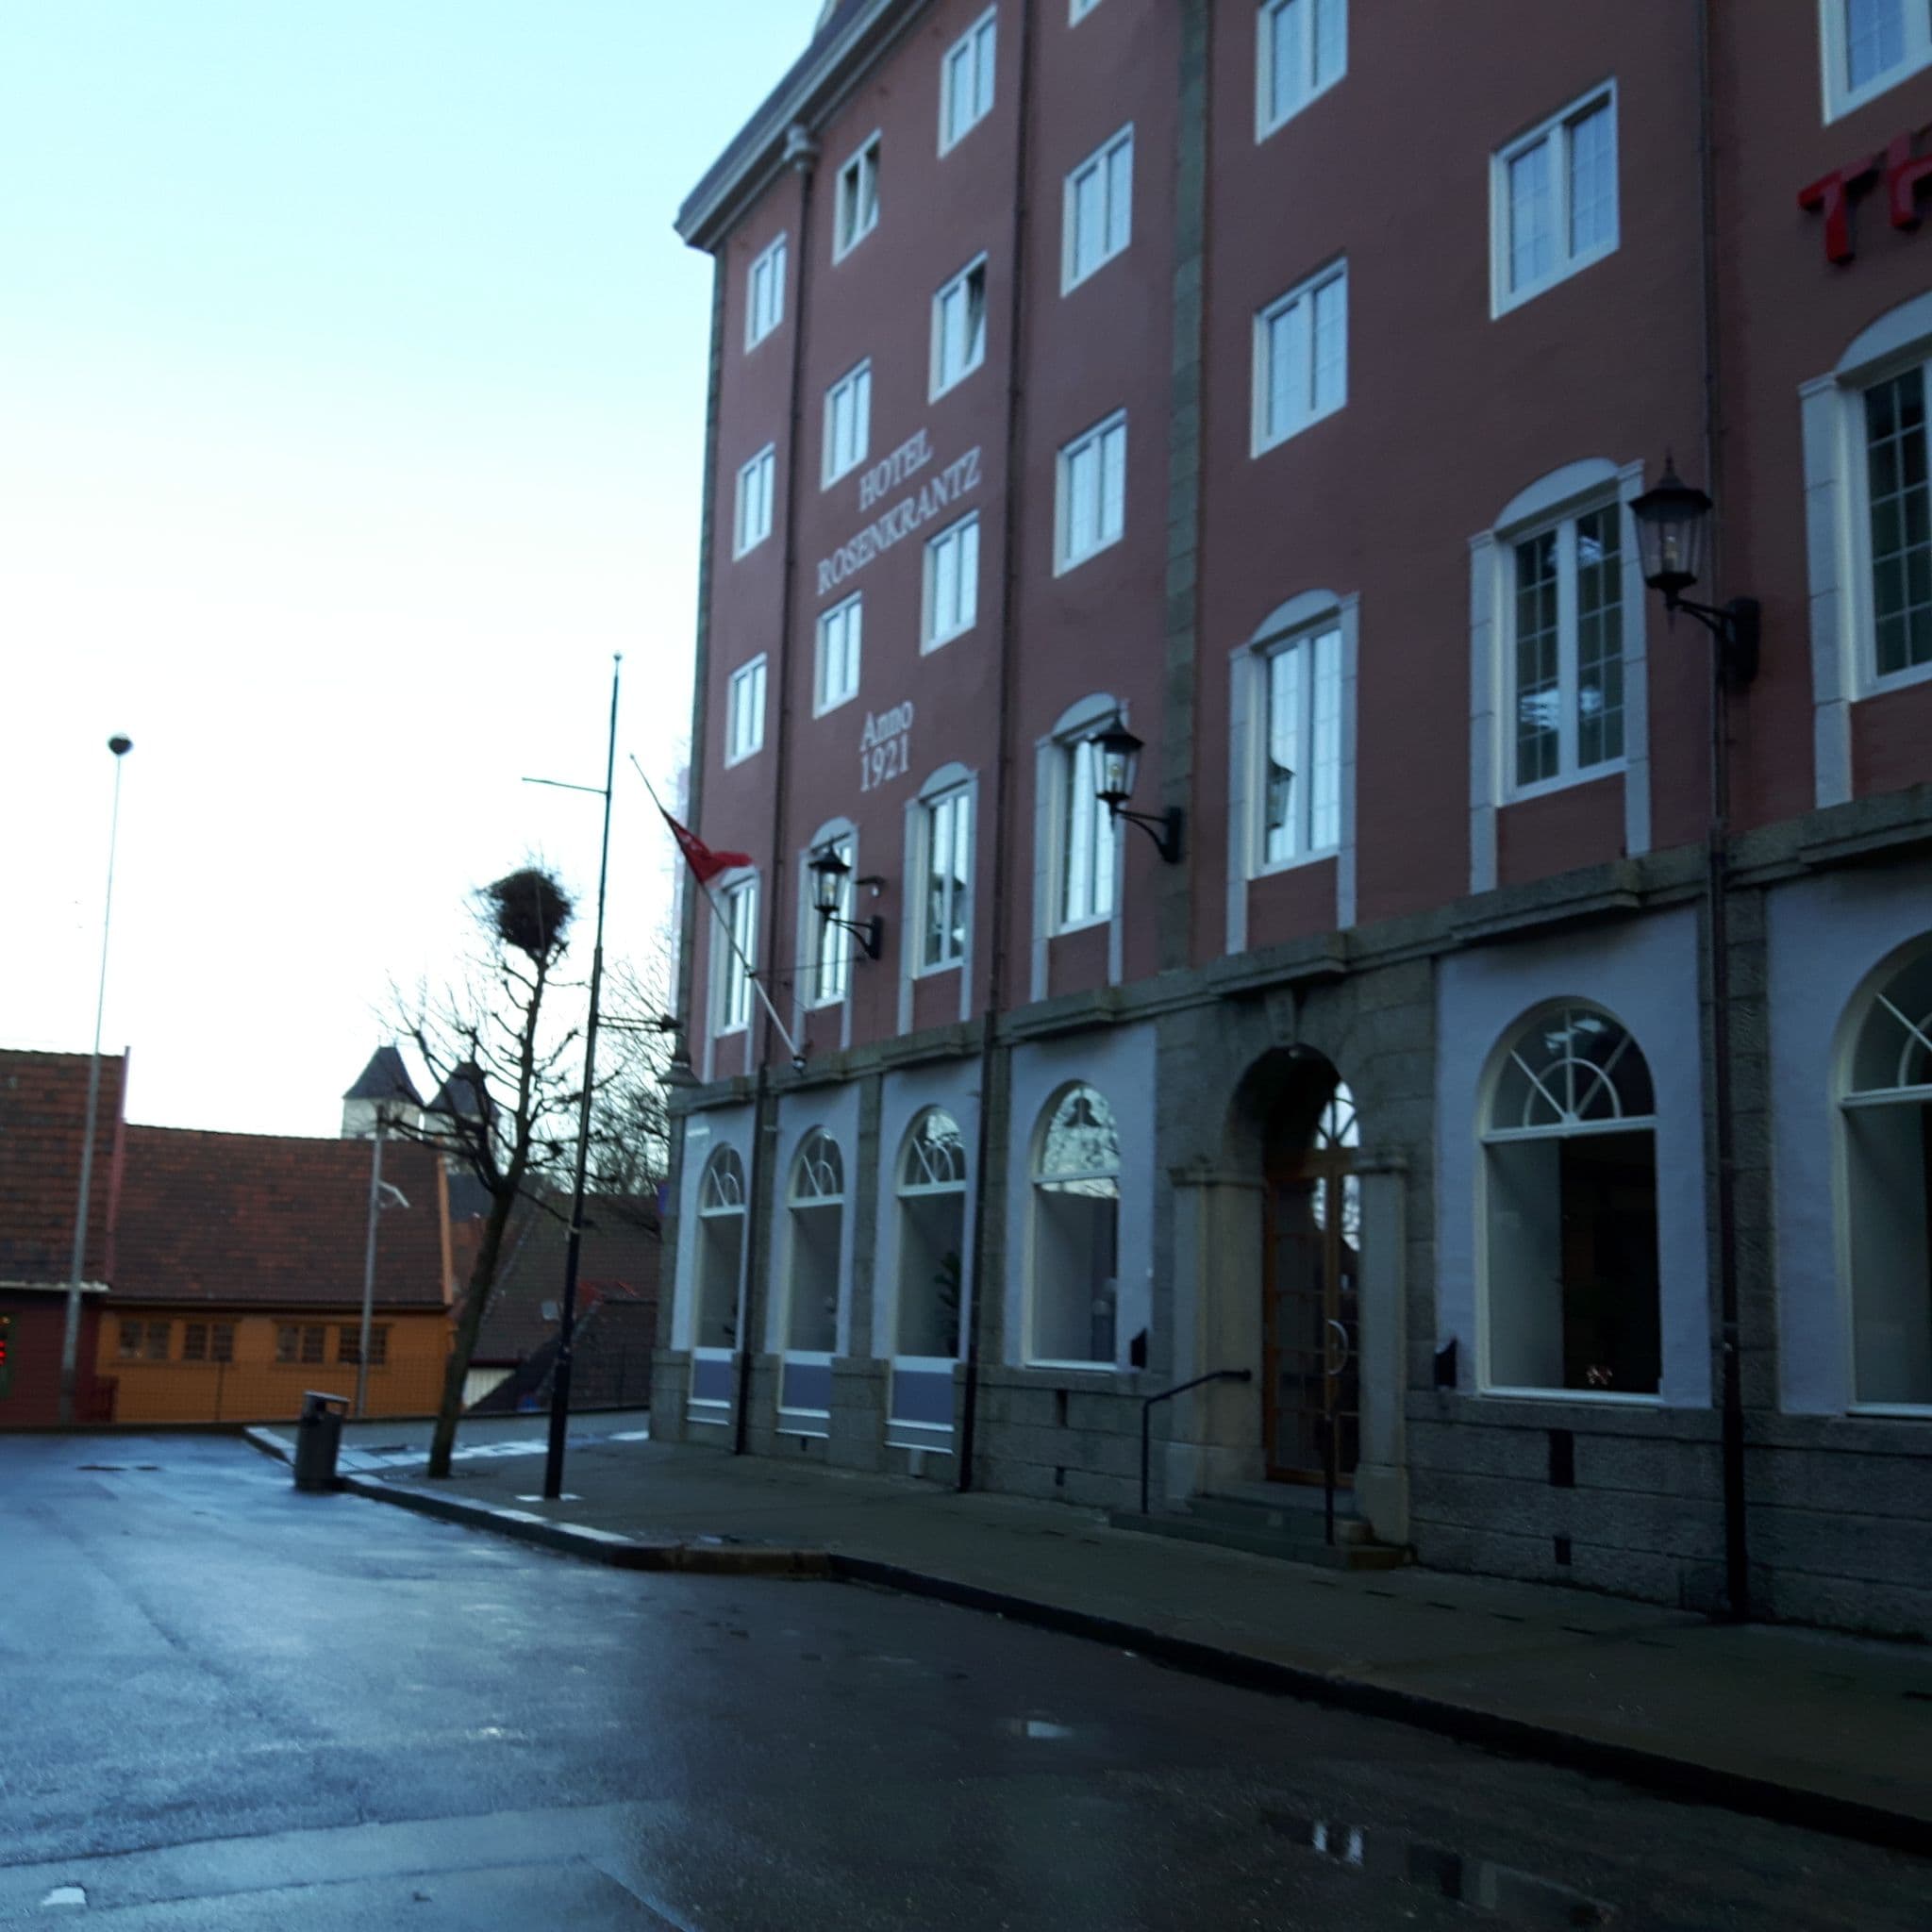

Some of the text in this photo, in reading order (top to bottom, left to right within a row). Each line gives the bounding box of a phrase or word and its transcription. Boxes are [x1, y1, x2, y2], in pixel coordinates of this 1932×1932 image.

[858, 427, 933, 512] HOTEL
[816, 445, 982, 596] ROSENKRANTZ
[859, 701, 914, 752] Anno
[860, 733, 910, 792] 1921
